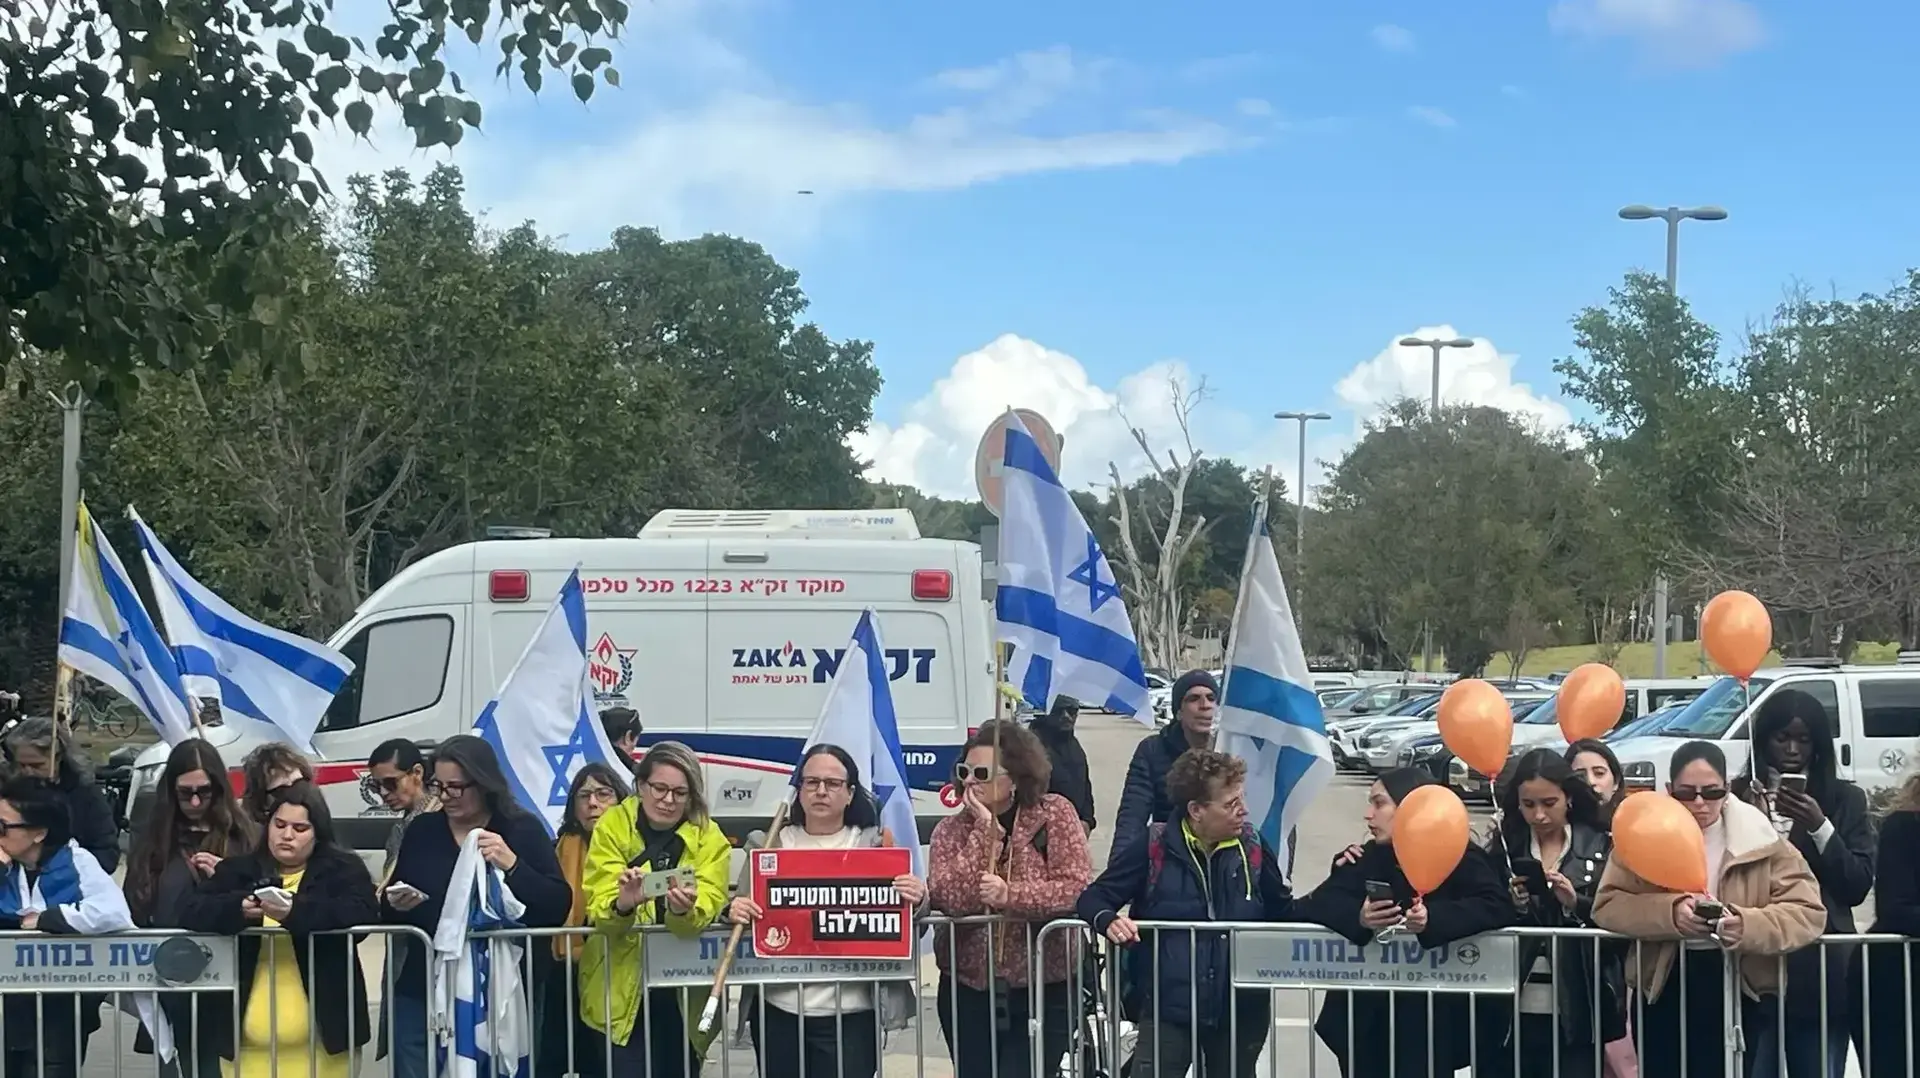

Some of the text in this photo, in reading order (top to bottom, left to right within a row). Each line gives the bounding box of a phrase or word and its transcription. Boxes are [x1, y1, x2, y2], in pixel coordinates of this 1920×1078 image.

[635, 576, 675, 594] מכל
[683, 579, 733, 594] 1223
[796, 579, 845, 597] מוקד
[590, 661, 619, 692] זקא
[731, 672, 808, 684] רגע של אמת
[944, 789, 957, 804] 4
[770, 886, 900, 906] חטופות וחטופים
[818, 909, 901, 934] תחילה!
[15, 943, 158, 968] שת במות
[1291, 938, 1449, 969] קשת במות
[1256, 967, 1400, 981] www.kstisrael.co.il
